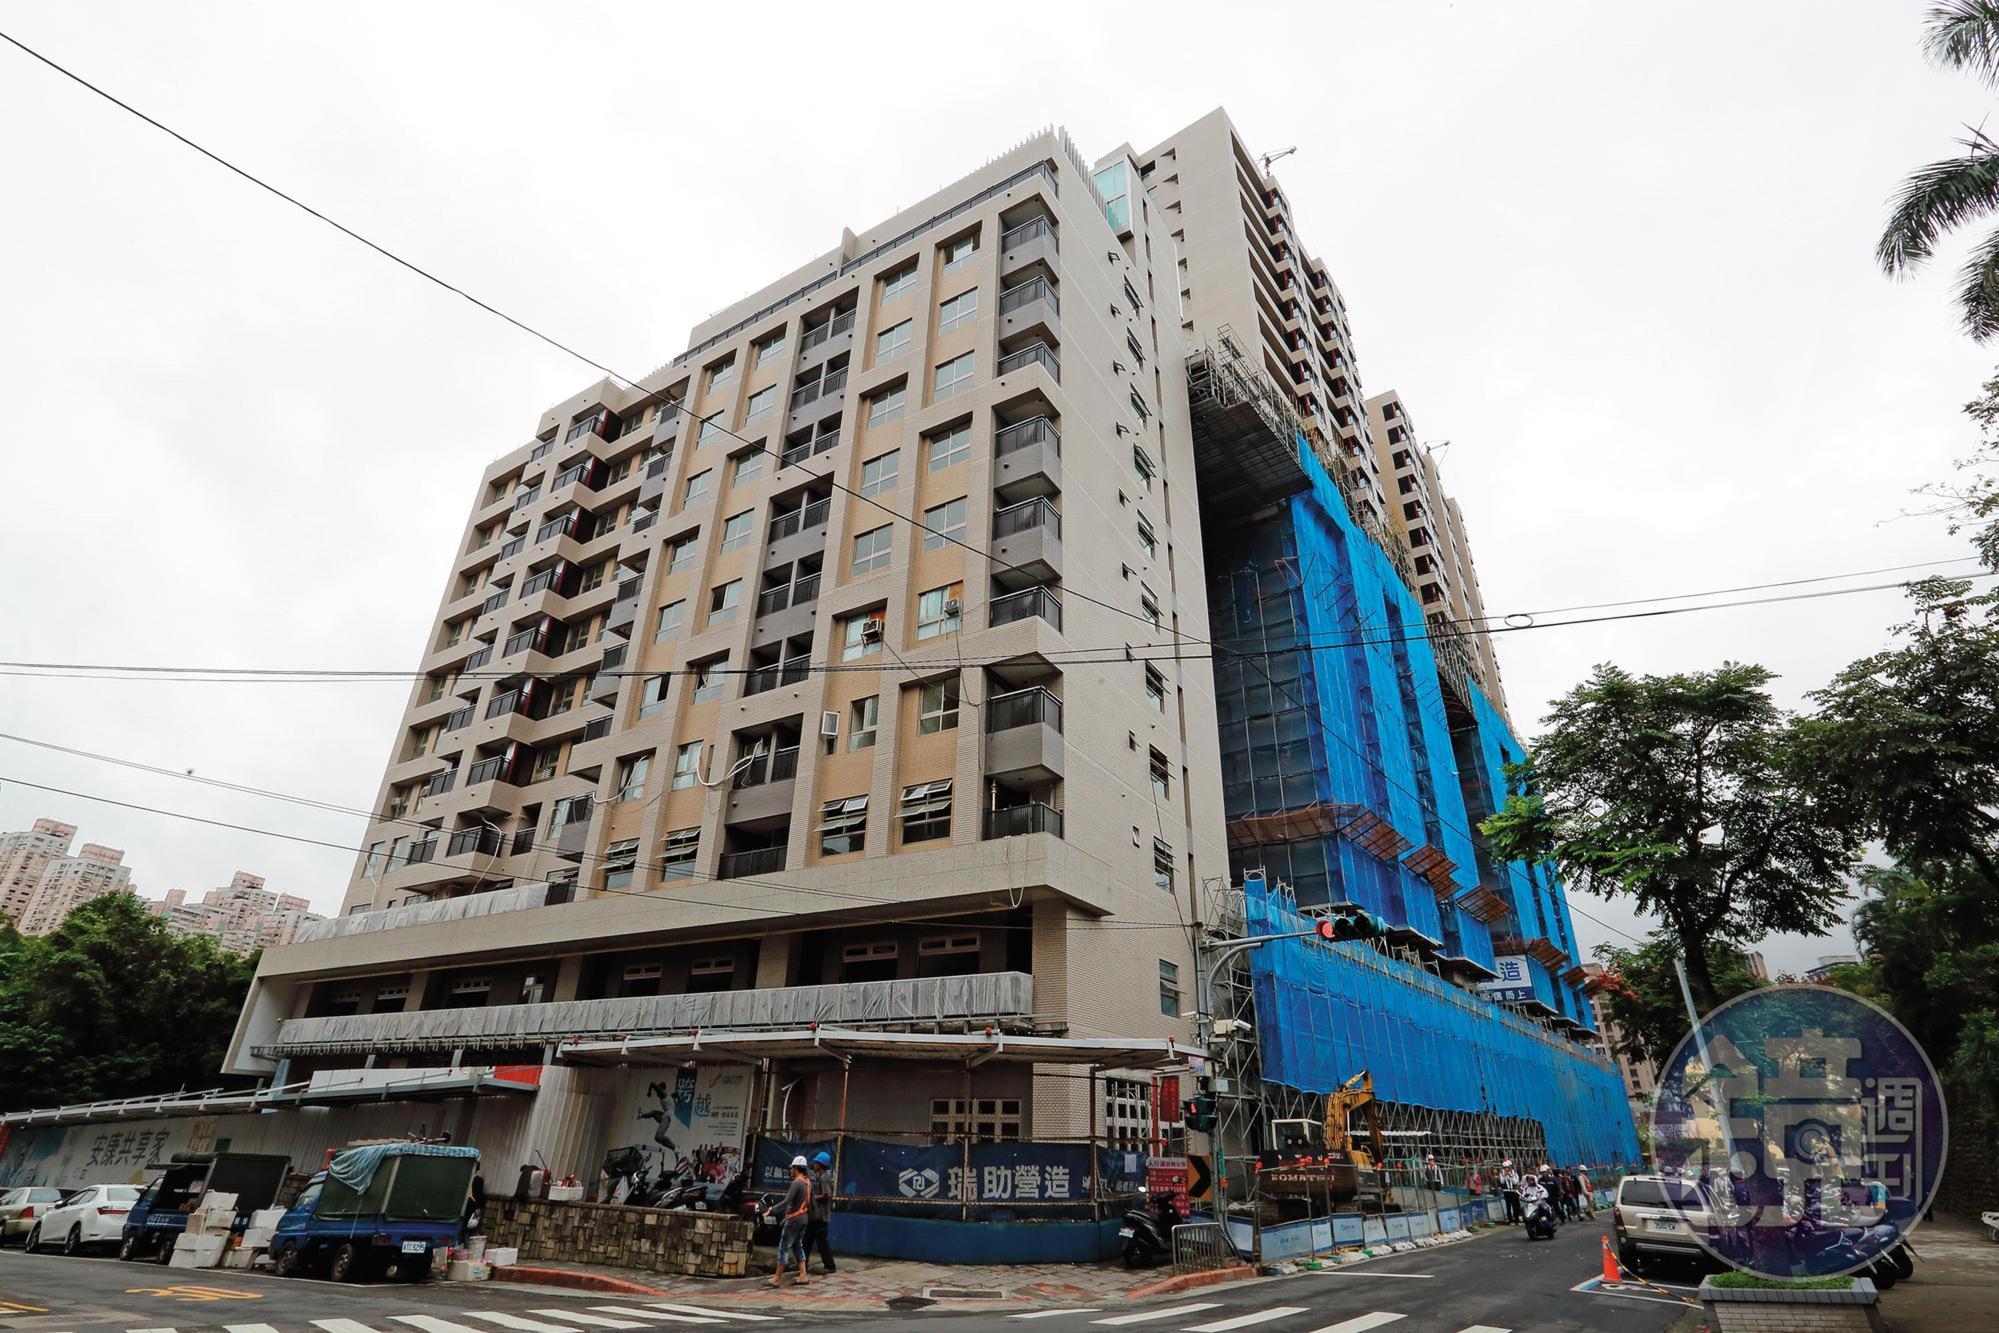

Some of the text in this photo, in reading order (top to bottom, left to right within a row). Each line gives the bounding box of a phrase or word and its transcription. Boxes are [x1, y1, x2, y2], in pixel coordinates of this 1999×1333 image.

[1499, 961, 1522, 982] 造
[86, 1127, 170, 1167] 安康共享家
[948, 1164, 1070, 1200] 瑞助營造
